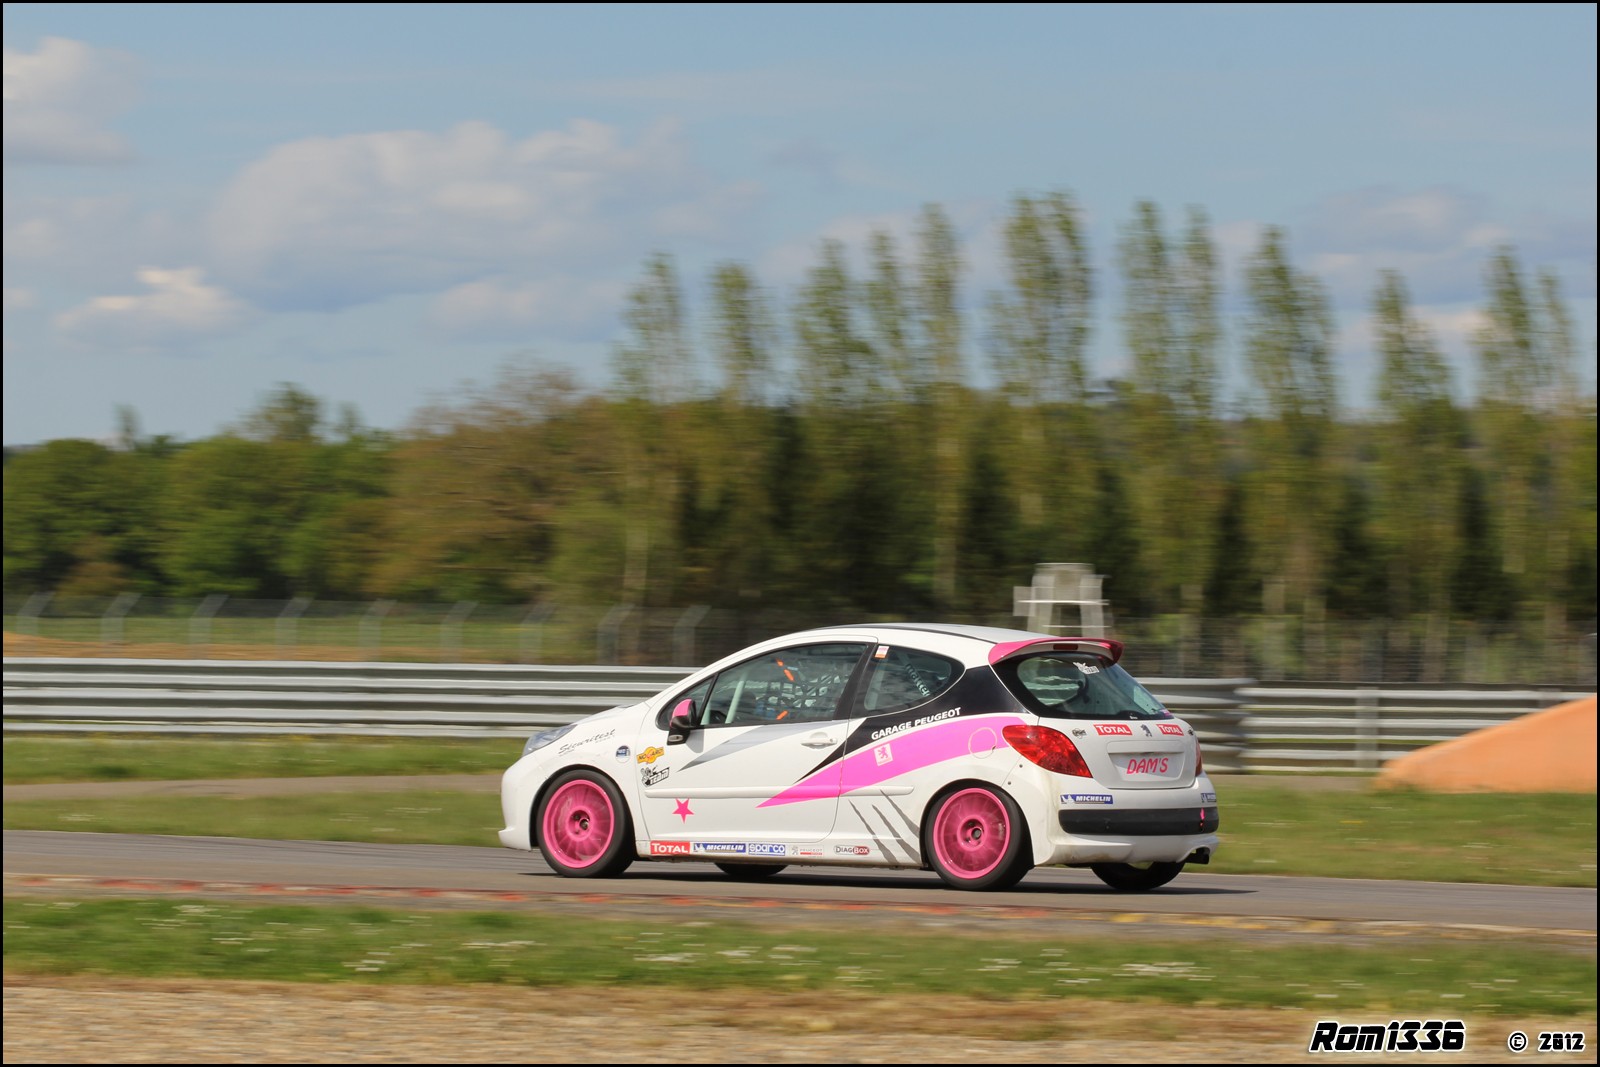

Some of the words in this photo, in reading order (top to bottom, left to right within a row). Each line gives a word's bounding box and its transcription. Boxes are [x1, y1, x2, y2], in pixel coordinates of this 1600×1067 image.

[871, 721, 912, 740] GARAGE
[914, 707, 961, 726] PEUGEOT
[1095, 725, 1131, 734] TOTAL
[1159, 725, 1183, 734] TOTAL
[1126, 758, 1169, 774] DAM'S
[651, 843, 689, 853] TOTAL
[749, 844, 785, 852] sparco
